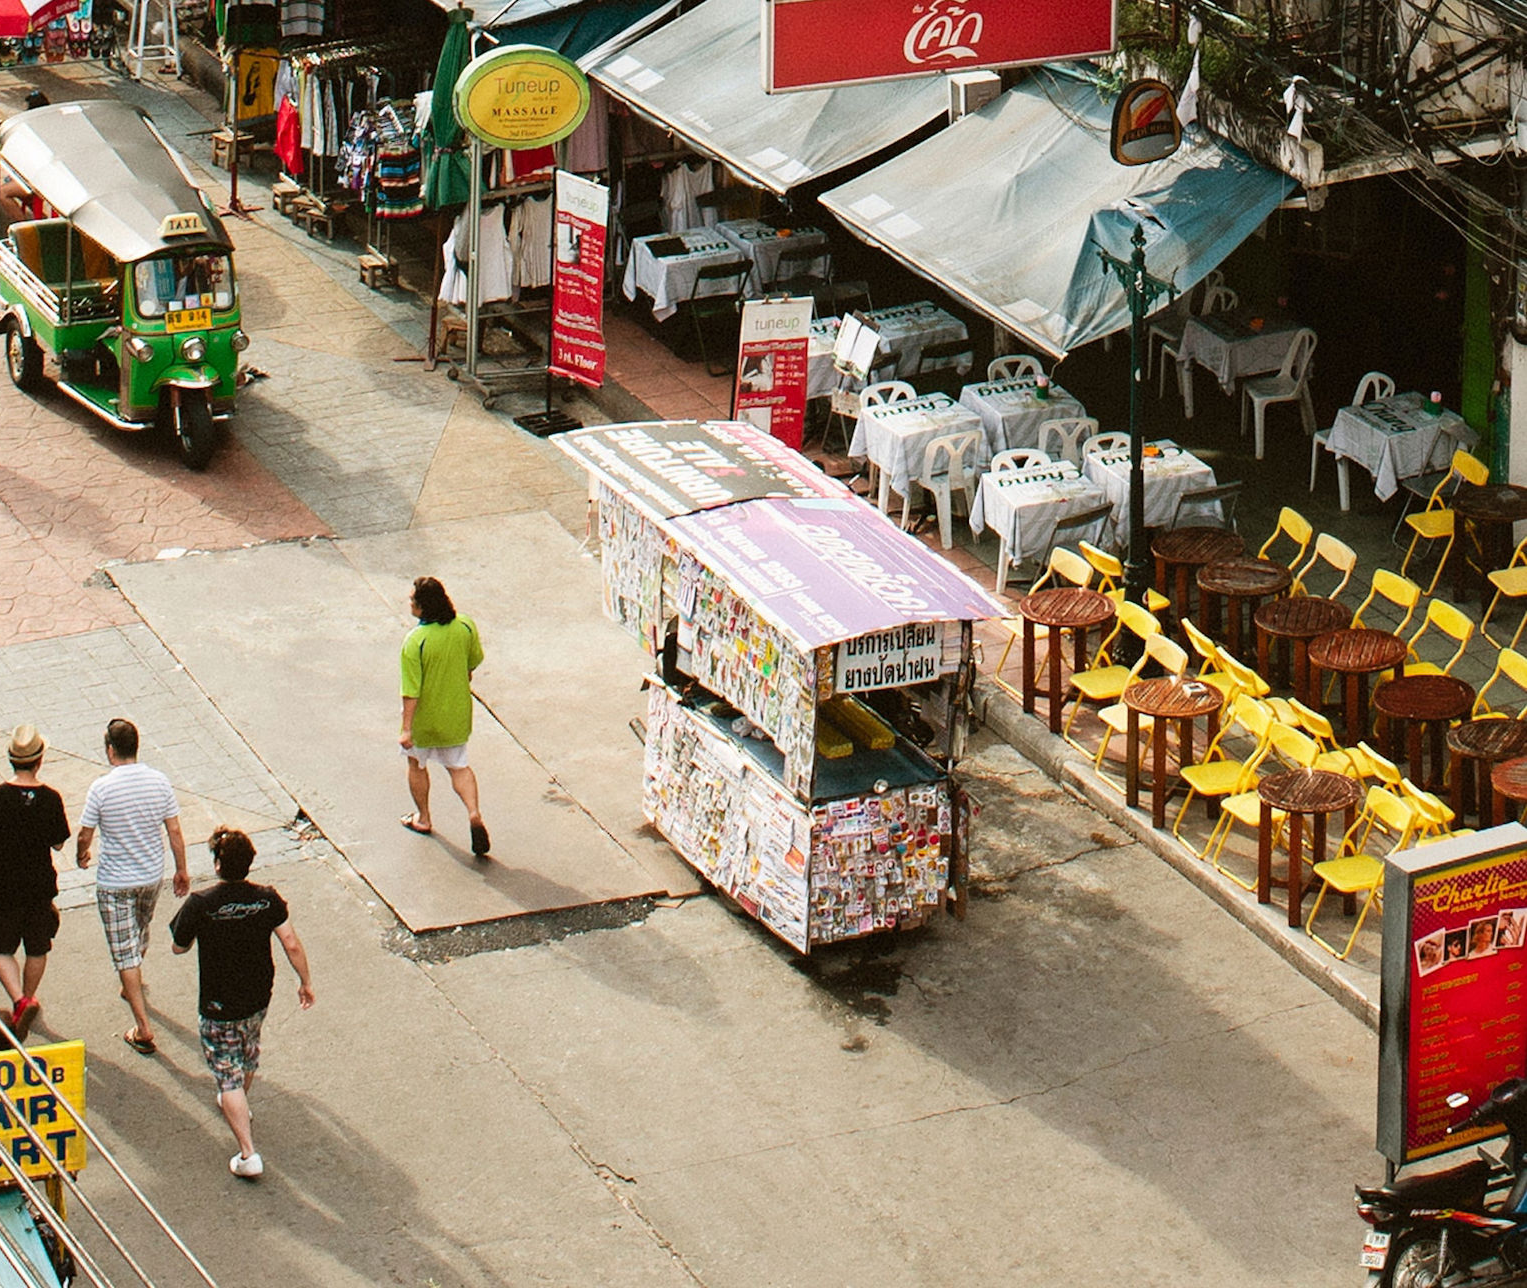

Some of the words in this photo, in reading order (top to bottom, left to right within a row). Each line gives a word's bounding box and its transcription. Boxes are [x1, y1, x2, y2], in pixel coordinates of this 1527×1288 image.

[495, 76, 561, 97] Tuneup
[492, 106, 559, 118] MASSAGE
[169, 217, 198, 231] TAXI
[754, 316, 801, 331] tuneup
[873, 395, 956, 420] Chang
[997, 466, 1085, 489] Chang
[1433, 873, 1510, 913] Charlie
